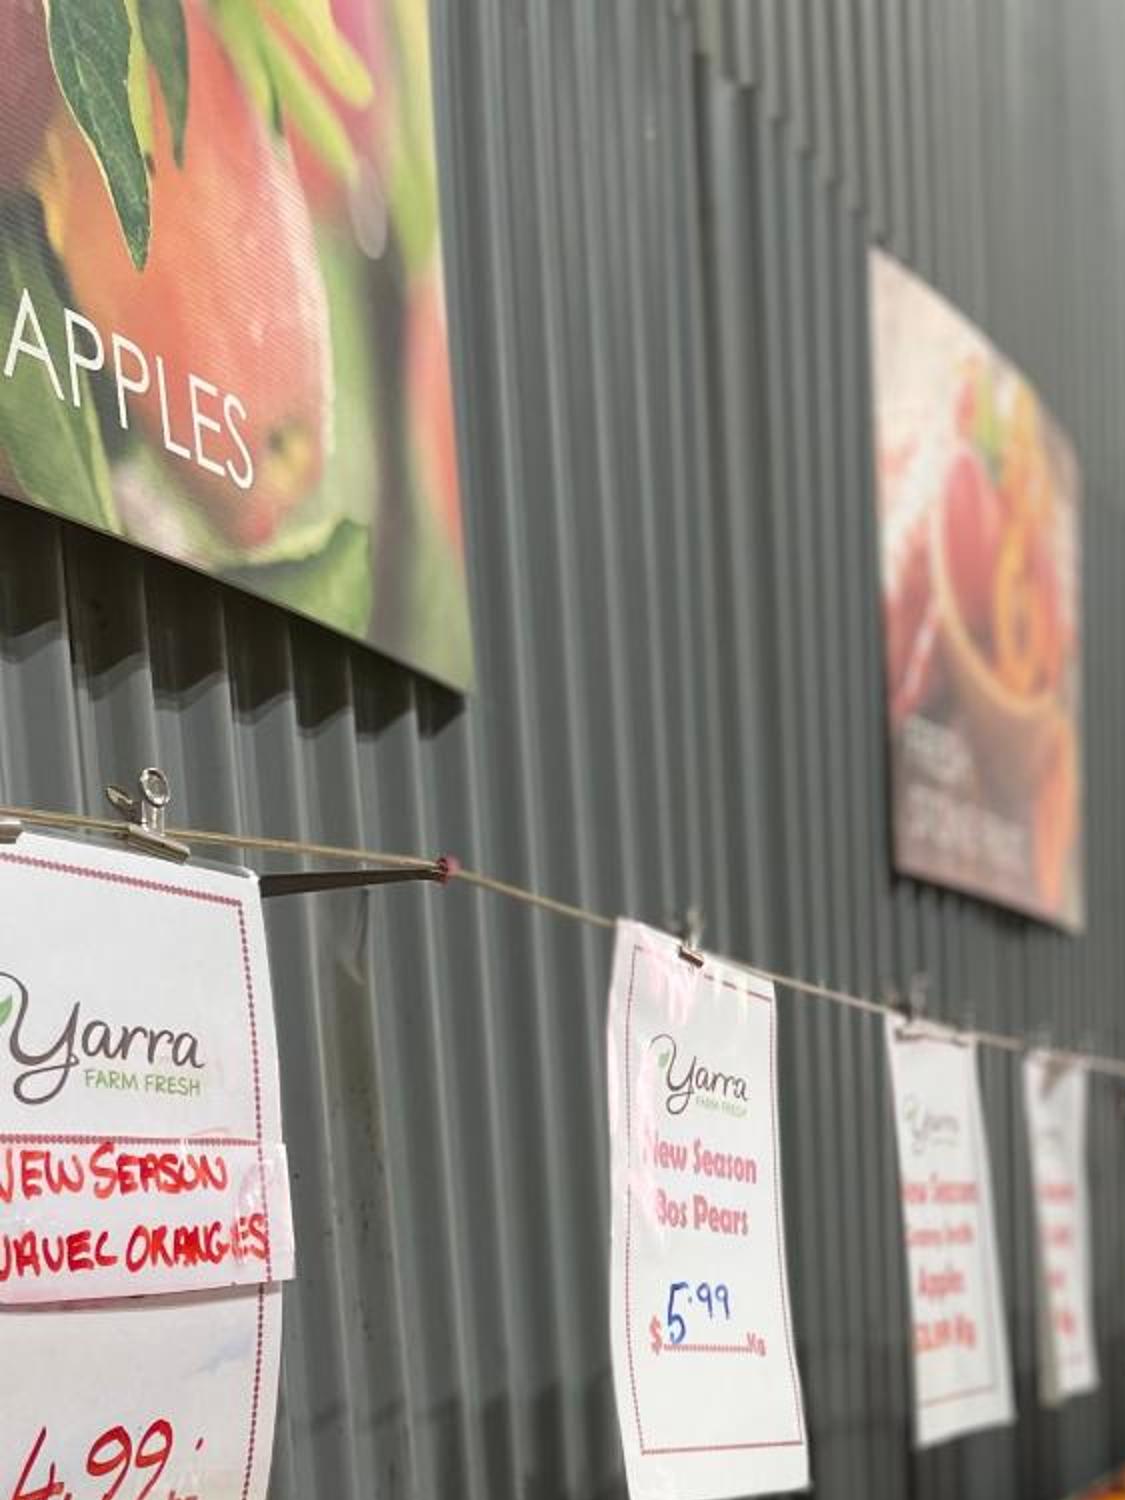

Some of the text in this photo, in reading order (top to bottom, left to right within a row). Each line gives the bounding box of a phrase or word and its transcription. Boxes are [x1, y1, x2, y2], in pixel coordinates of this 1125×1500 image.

[4, 288, 254, 489] APPLES
[0, 971, 205, 1105] Yarra
[83, 1068, 201, 1097] FARM FRESH
[650, 1033, 748, 1116] Yarra
[89, 1142, 231, 1199] SEASON
[693, 1138, 757, 1184] Season
[126, 1214, 268, 1273] ORANGES
[693, 1195, 748, 1236] Pears
